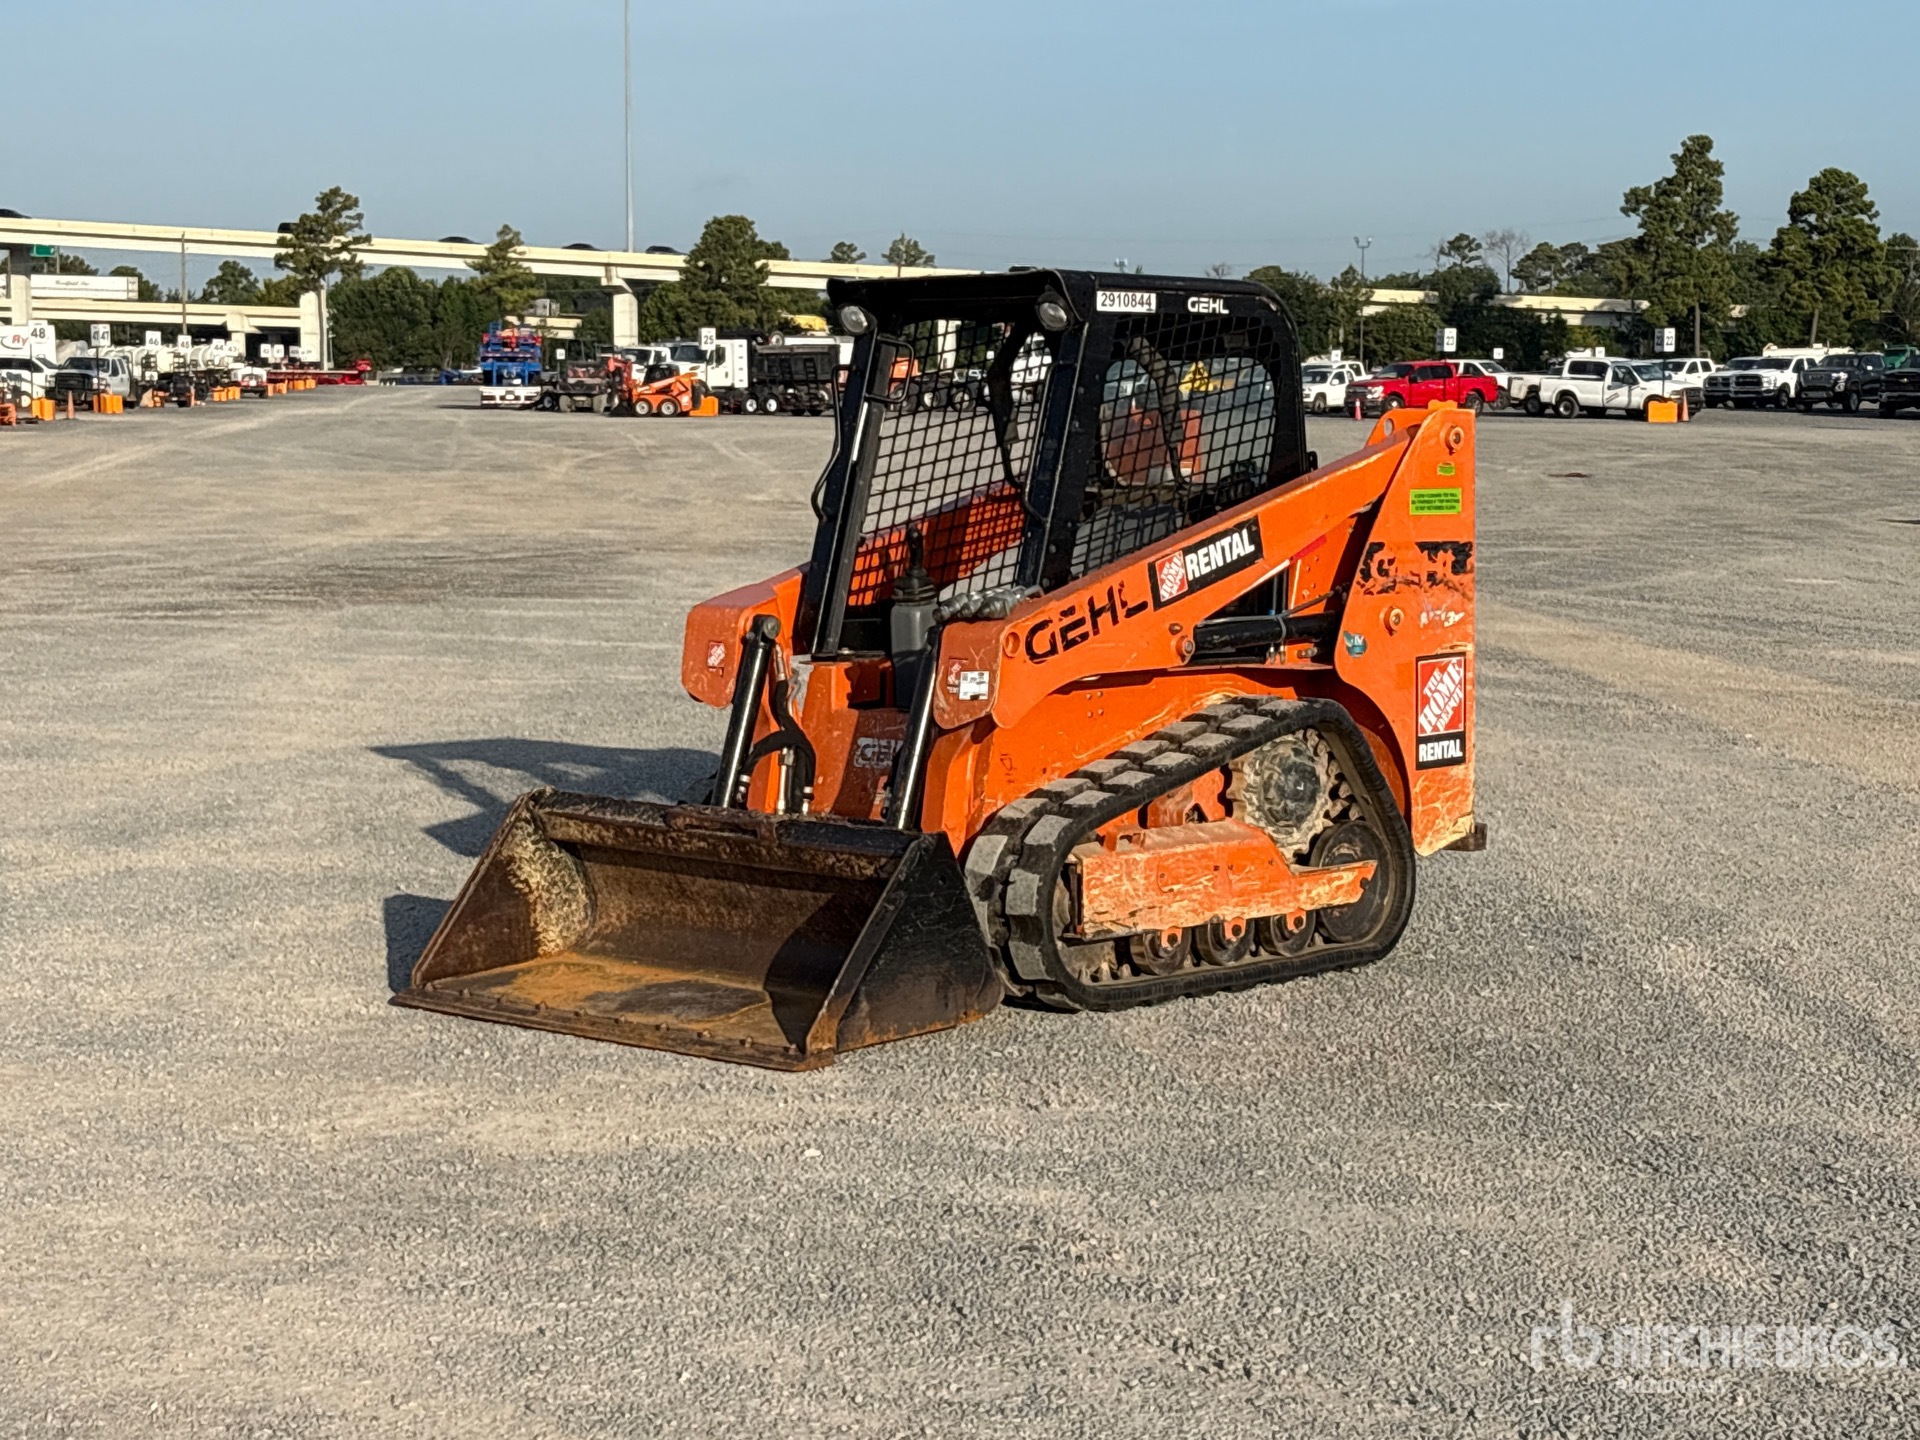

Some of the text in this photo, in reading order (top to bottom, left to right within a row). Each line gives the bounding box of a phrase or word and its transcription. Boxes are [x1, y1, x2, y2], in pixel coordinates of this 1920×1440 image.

[1100, 292, 1153, 308] 2910844
[1187, 296, 1230, 315] GEHL
[30, 327, 46, 339] 48
[703, 335, 715, 345] 25
[148, 337, 160, 346] 46
[180, 341, 190, 349] 45
[1445, 335, 1455, 346] 23
[1665, 335, 1674, 346] 22
[1185, 528, 1255, 581] RENTAL
[1423, 667, 1443, 698] THE
[1419, 659, 1464, 734] HOME
[1418, 739, 1463, 762] RENTAL
